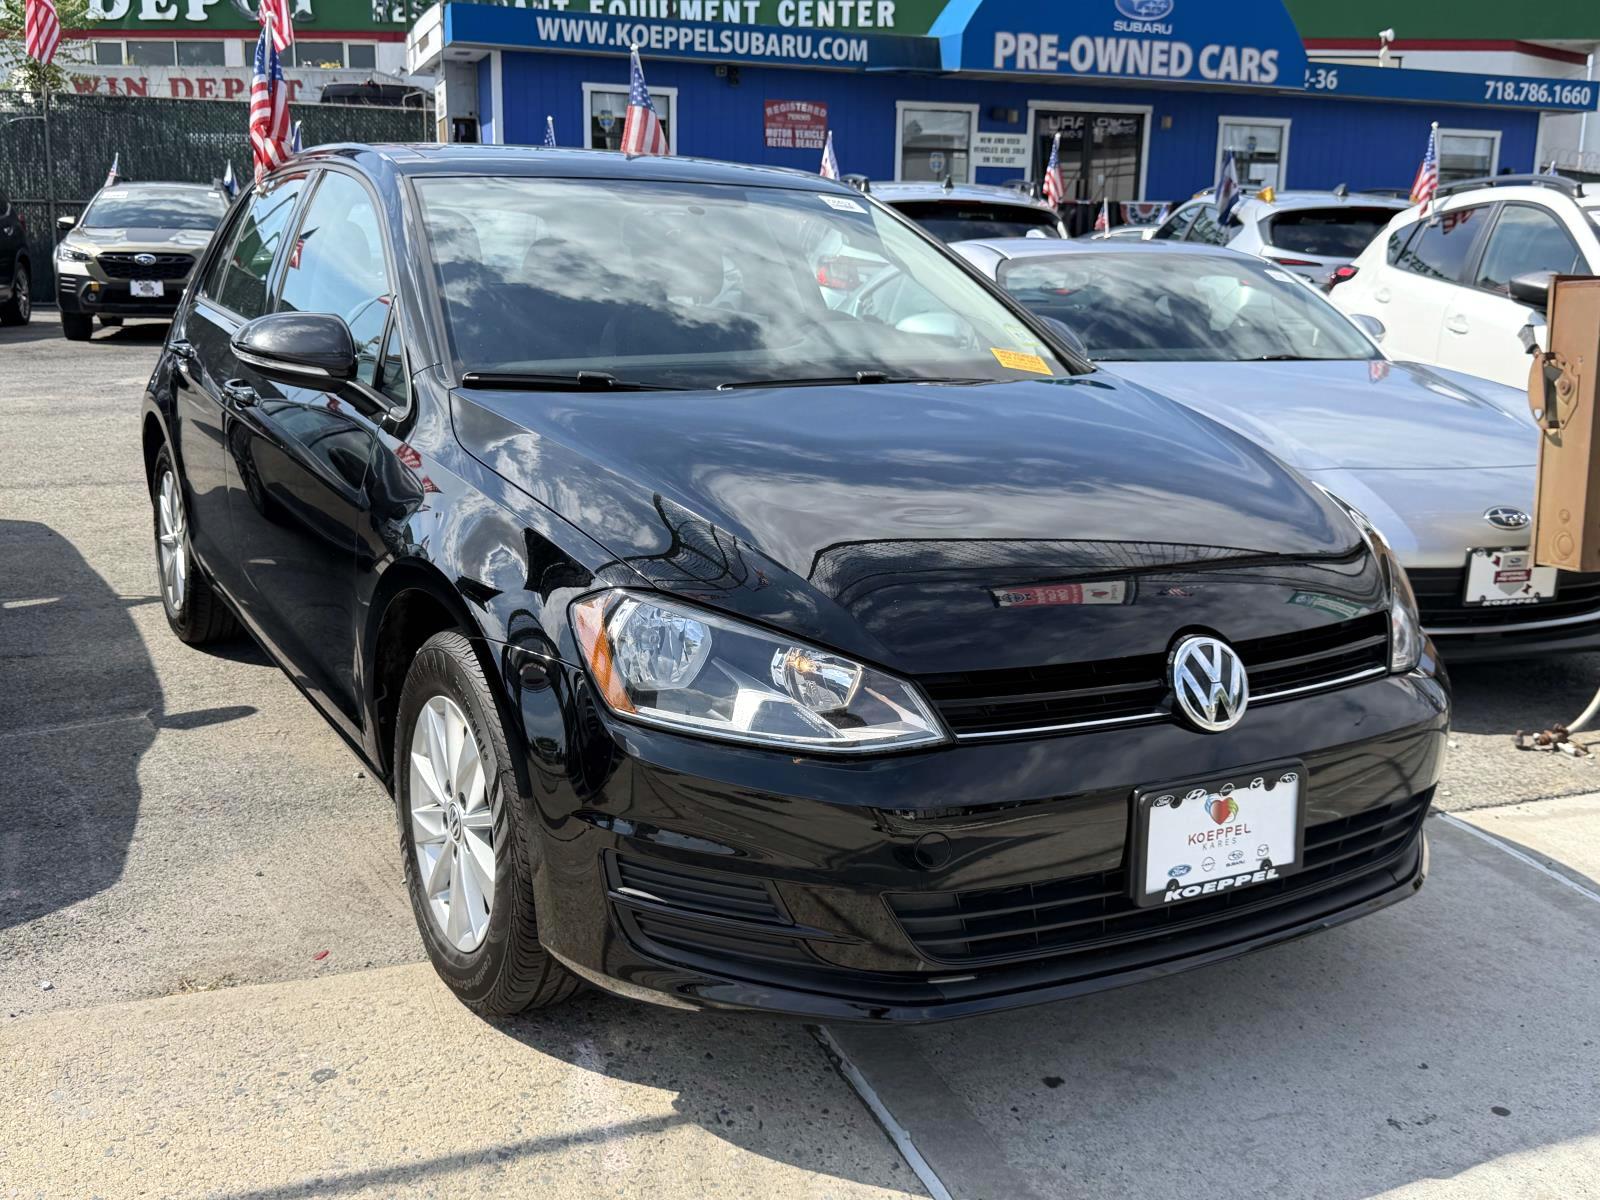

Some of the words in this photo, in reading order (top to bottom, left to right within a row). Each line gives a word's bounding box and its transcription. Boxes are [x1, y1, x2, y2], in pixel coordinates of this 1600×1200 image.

[777, 0, 895, 27] CENTER
[536, 16, 868, 62] WWW.KOEPPELSUBARU.COM
[1113, 20, 1173, 35] SUBARU
[993, 31, 1193, 78] PRE-OWNED
[1198, 44, 1280, 84] CARS
[70, 77, 148, 97] WIN
[168, 78, 304, 101] DEPT
[1484, 80, 1591, 105] 718.786.1660
[766, 101, 827, 117] REGISTERED
[1188, 823, 1252, 846] KOEPPEL
[1202, 837, 1238, 851] KARES
[1164, 869, 1279, 902] KOEPPEL
